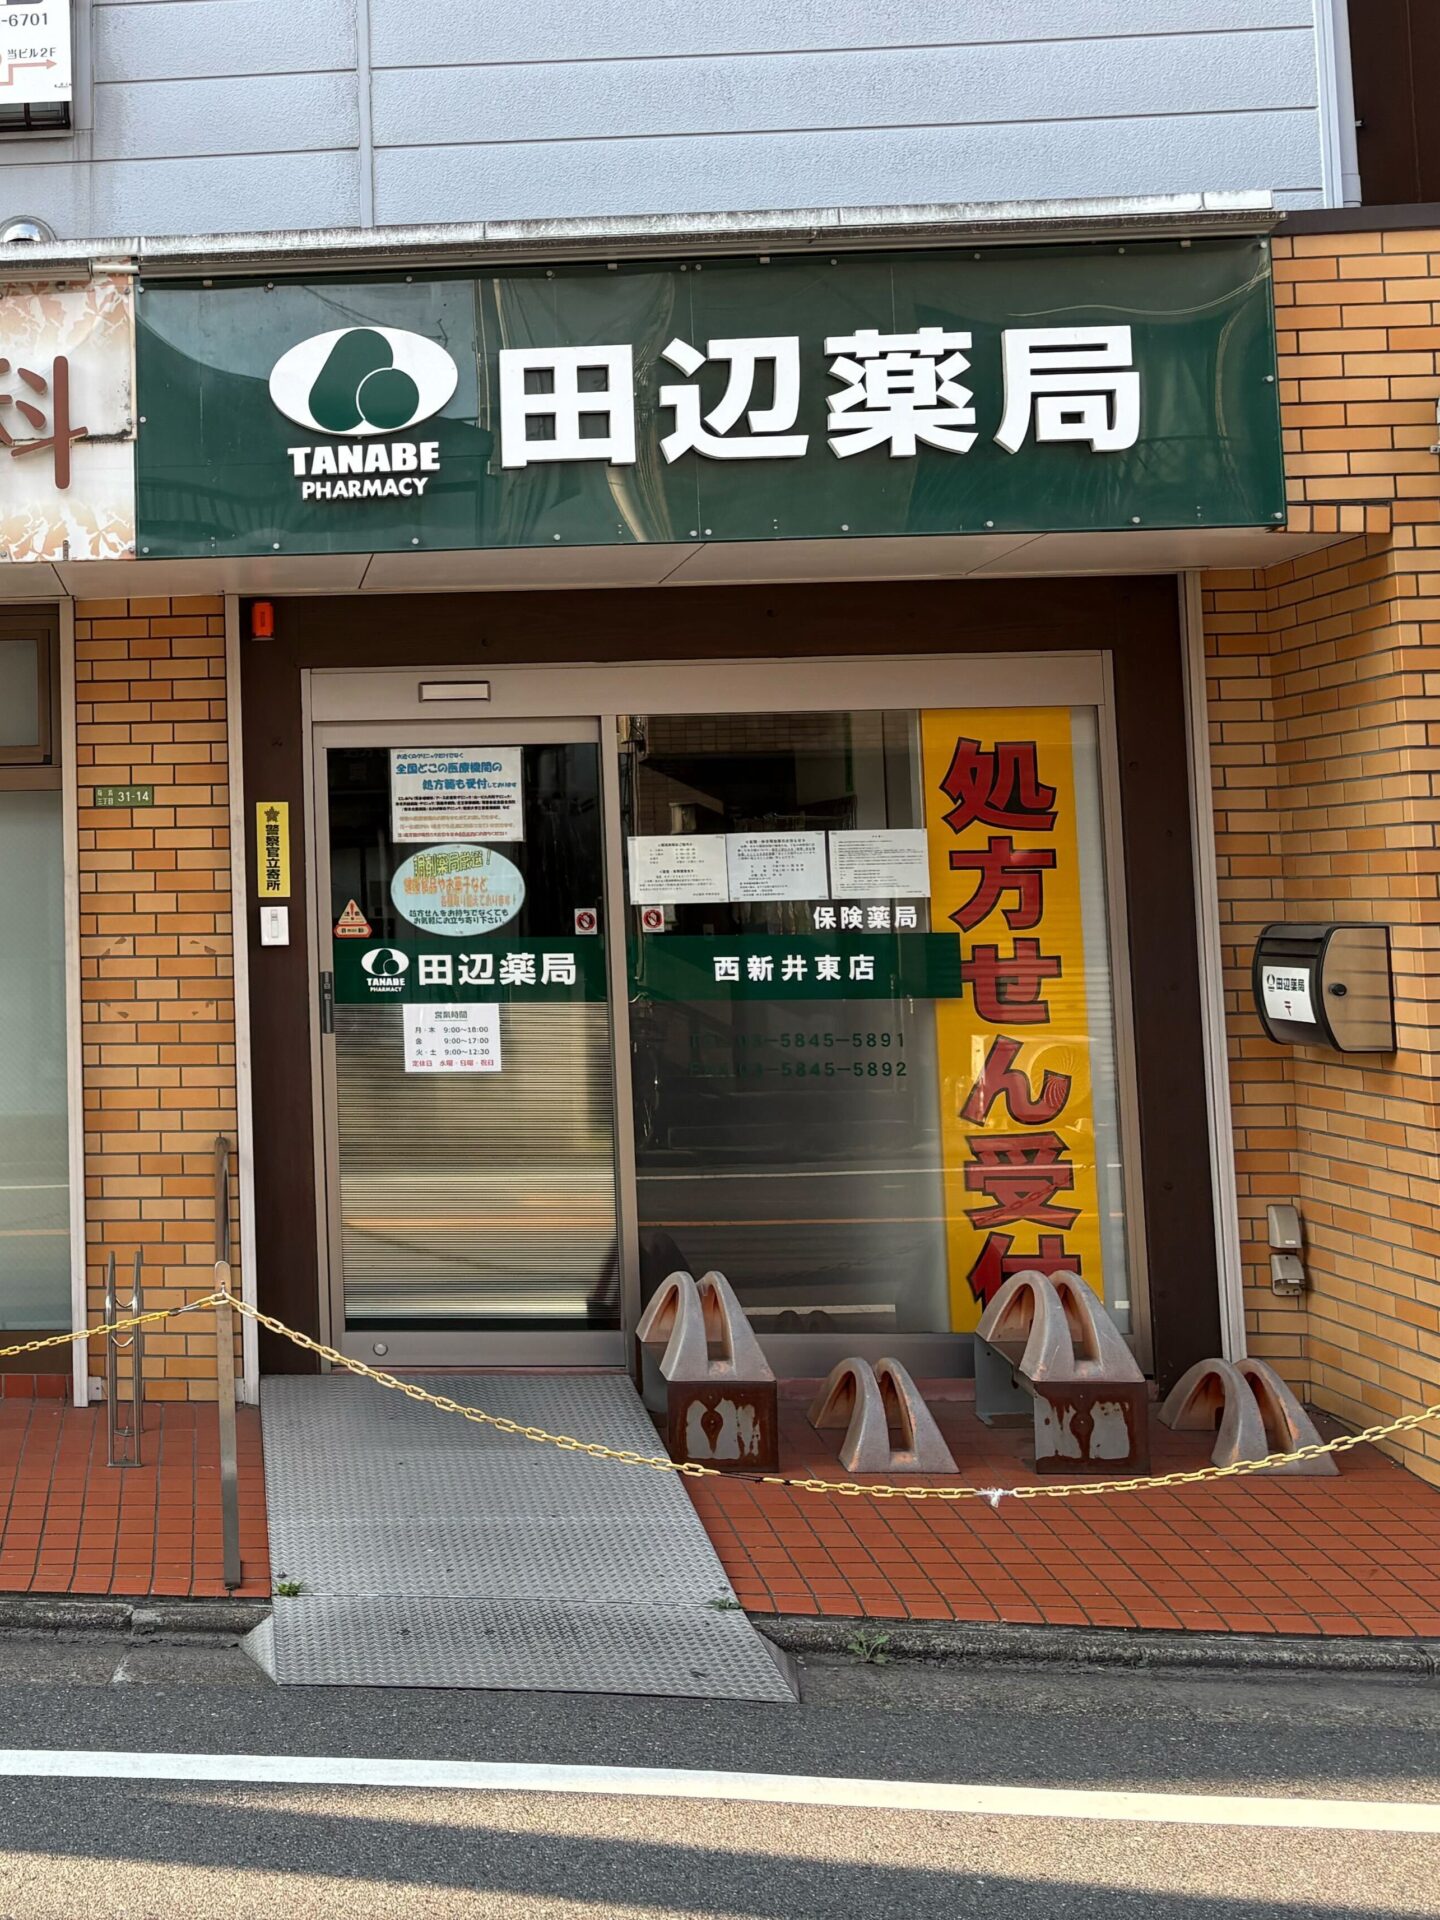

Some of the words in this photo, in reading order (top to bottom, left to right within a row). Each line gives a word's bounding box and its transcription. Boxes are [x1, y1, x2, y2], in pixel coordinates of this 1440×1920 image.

[7, 47, 57, 59] 当ビル2F
[499, 325, 1141, 469] 田辺薬局
[287, 441, 441, 477] TANABE
[301, 477, 430, 502] PHARMACY
[396, 762, 502, 774] 全国どこの医療機関の
[117, 791, 149, 802] 31-14
[265, 824, 281, 891] 警察官立寄所
[812, 905, 918, 930] 保険薬局
[417, 952, 577, 986] 田辺薬局
[712, 954, 876, 982] 西新井東店
[366, 977, 406, 986] TANABE
[434, 1010, 468, 1019] 営業時間
